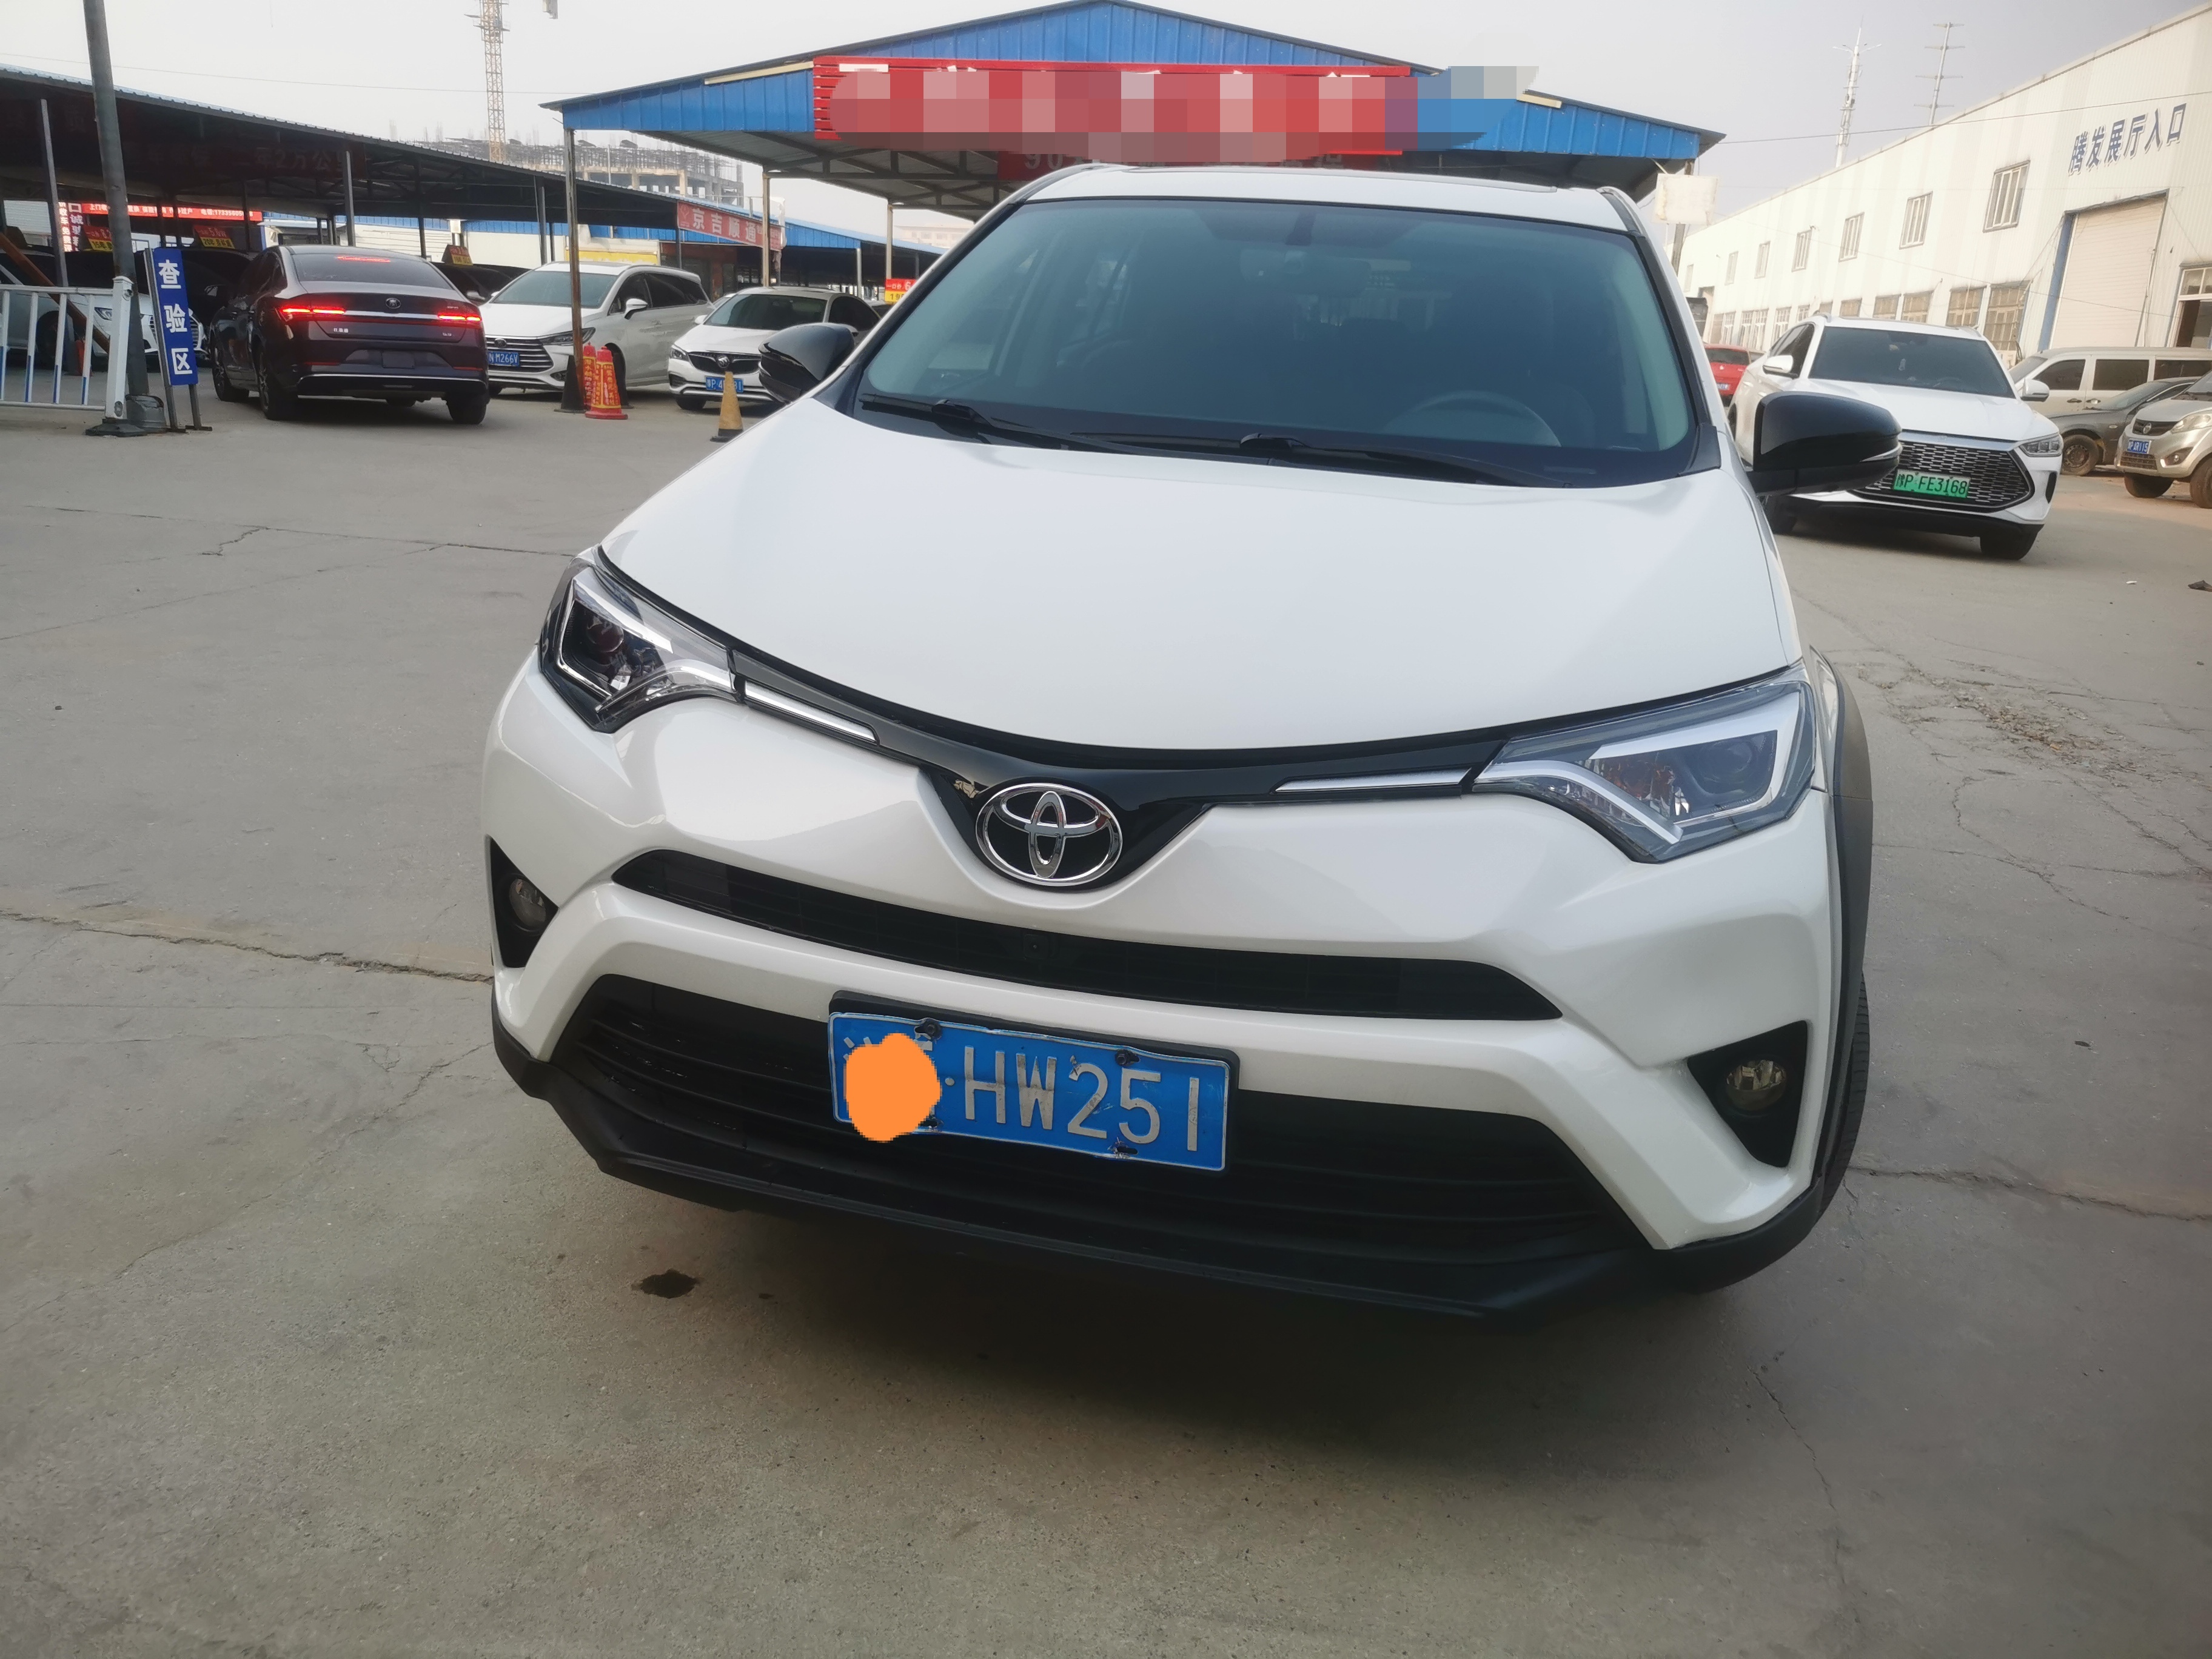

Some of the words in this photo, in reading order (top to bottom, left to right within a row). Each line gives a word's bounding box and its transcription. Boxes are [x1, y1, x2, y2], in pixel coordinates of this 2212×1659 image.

[2068, 102, 2187, 176] 腾发展厅入口
[692, 209, 756, 242] 京吉顺通
[158, 259, 193, 375] 查验区
